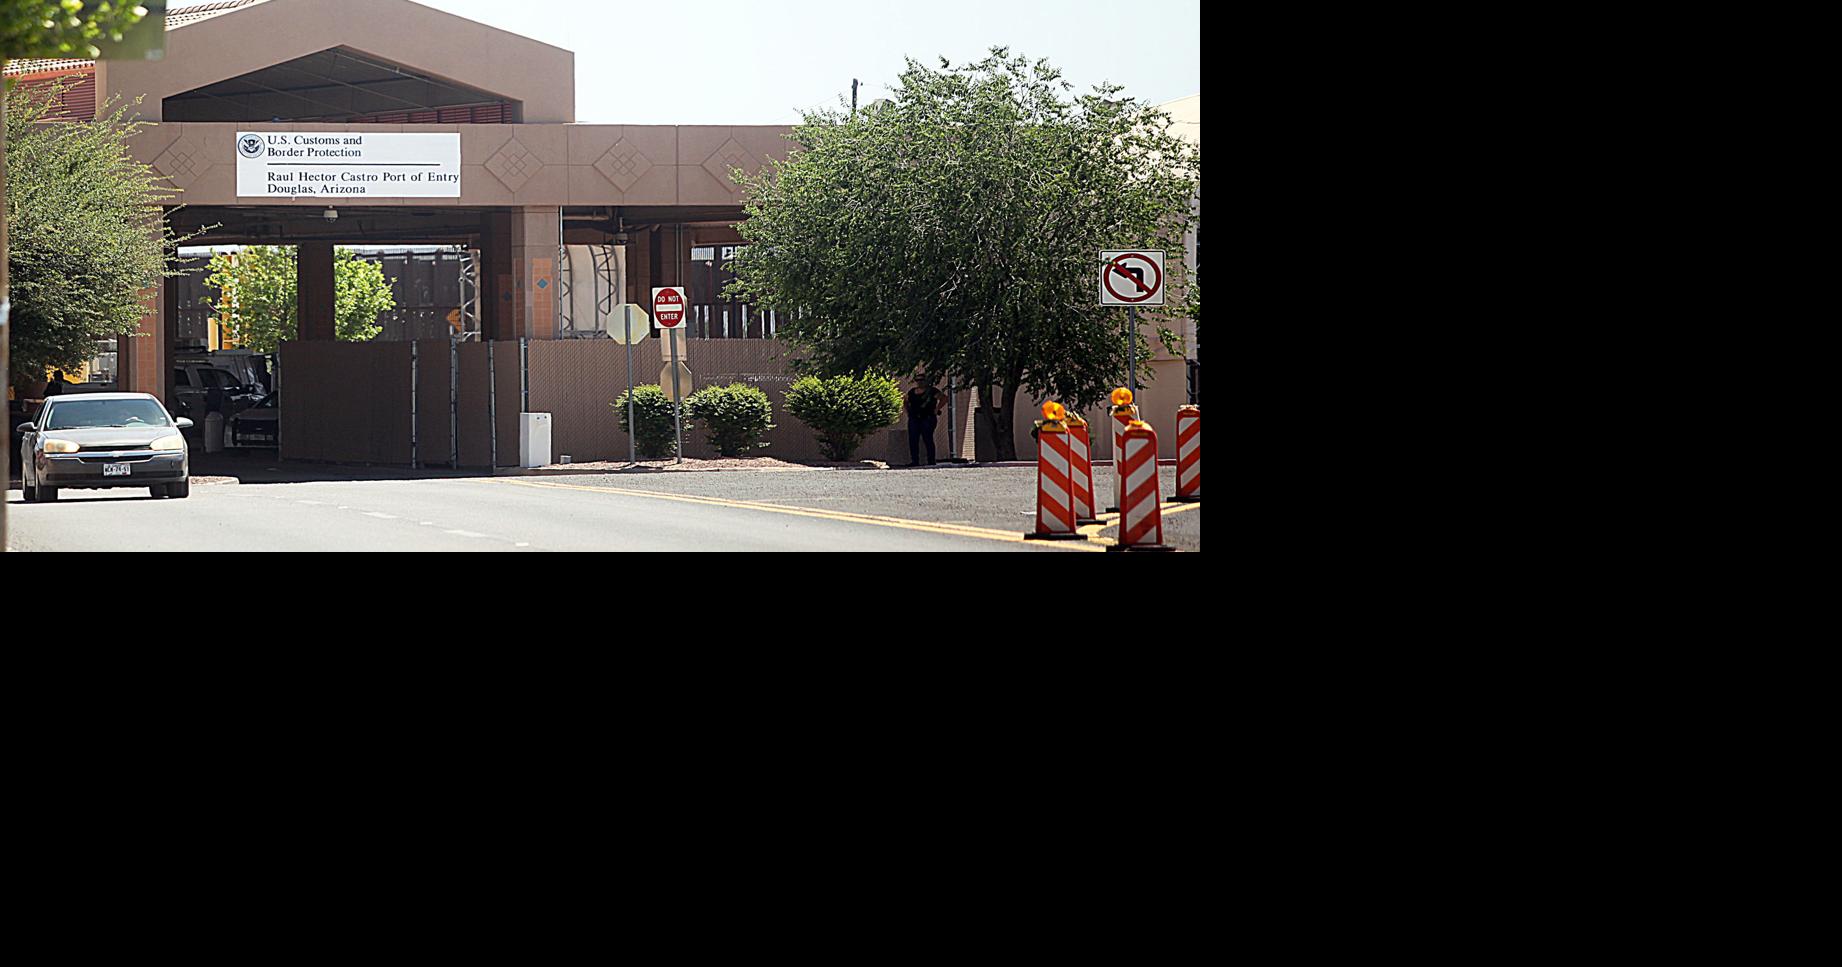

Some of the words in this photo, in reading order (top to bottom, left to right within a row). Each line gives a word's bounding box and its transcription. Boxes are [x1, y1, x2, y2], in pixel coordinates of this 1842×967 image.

[267, 135, 291, 145] U.S.
[294, 135, 340, 145] Customs
[343, 135, 362, 145] and
[267, 147, 304, 157] Border
[307, 147, 361, 157] Protection
[267, 172, 293, 182] Raul
[299, 171, 336, 181] Hector
[341, 172, 378, 182] Castro
[383, 172, 406, 182] Port
[410, 172, 423, 182] of
[428, 172, 459, 183] Entry
[267, 184, 316, 195] Douglas,
[320, 184, 366, 194] Arizona
